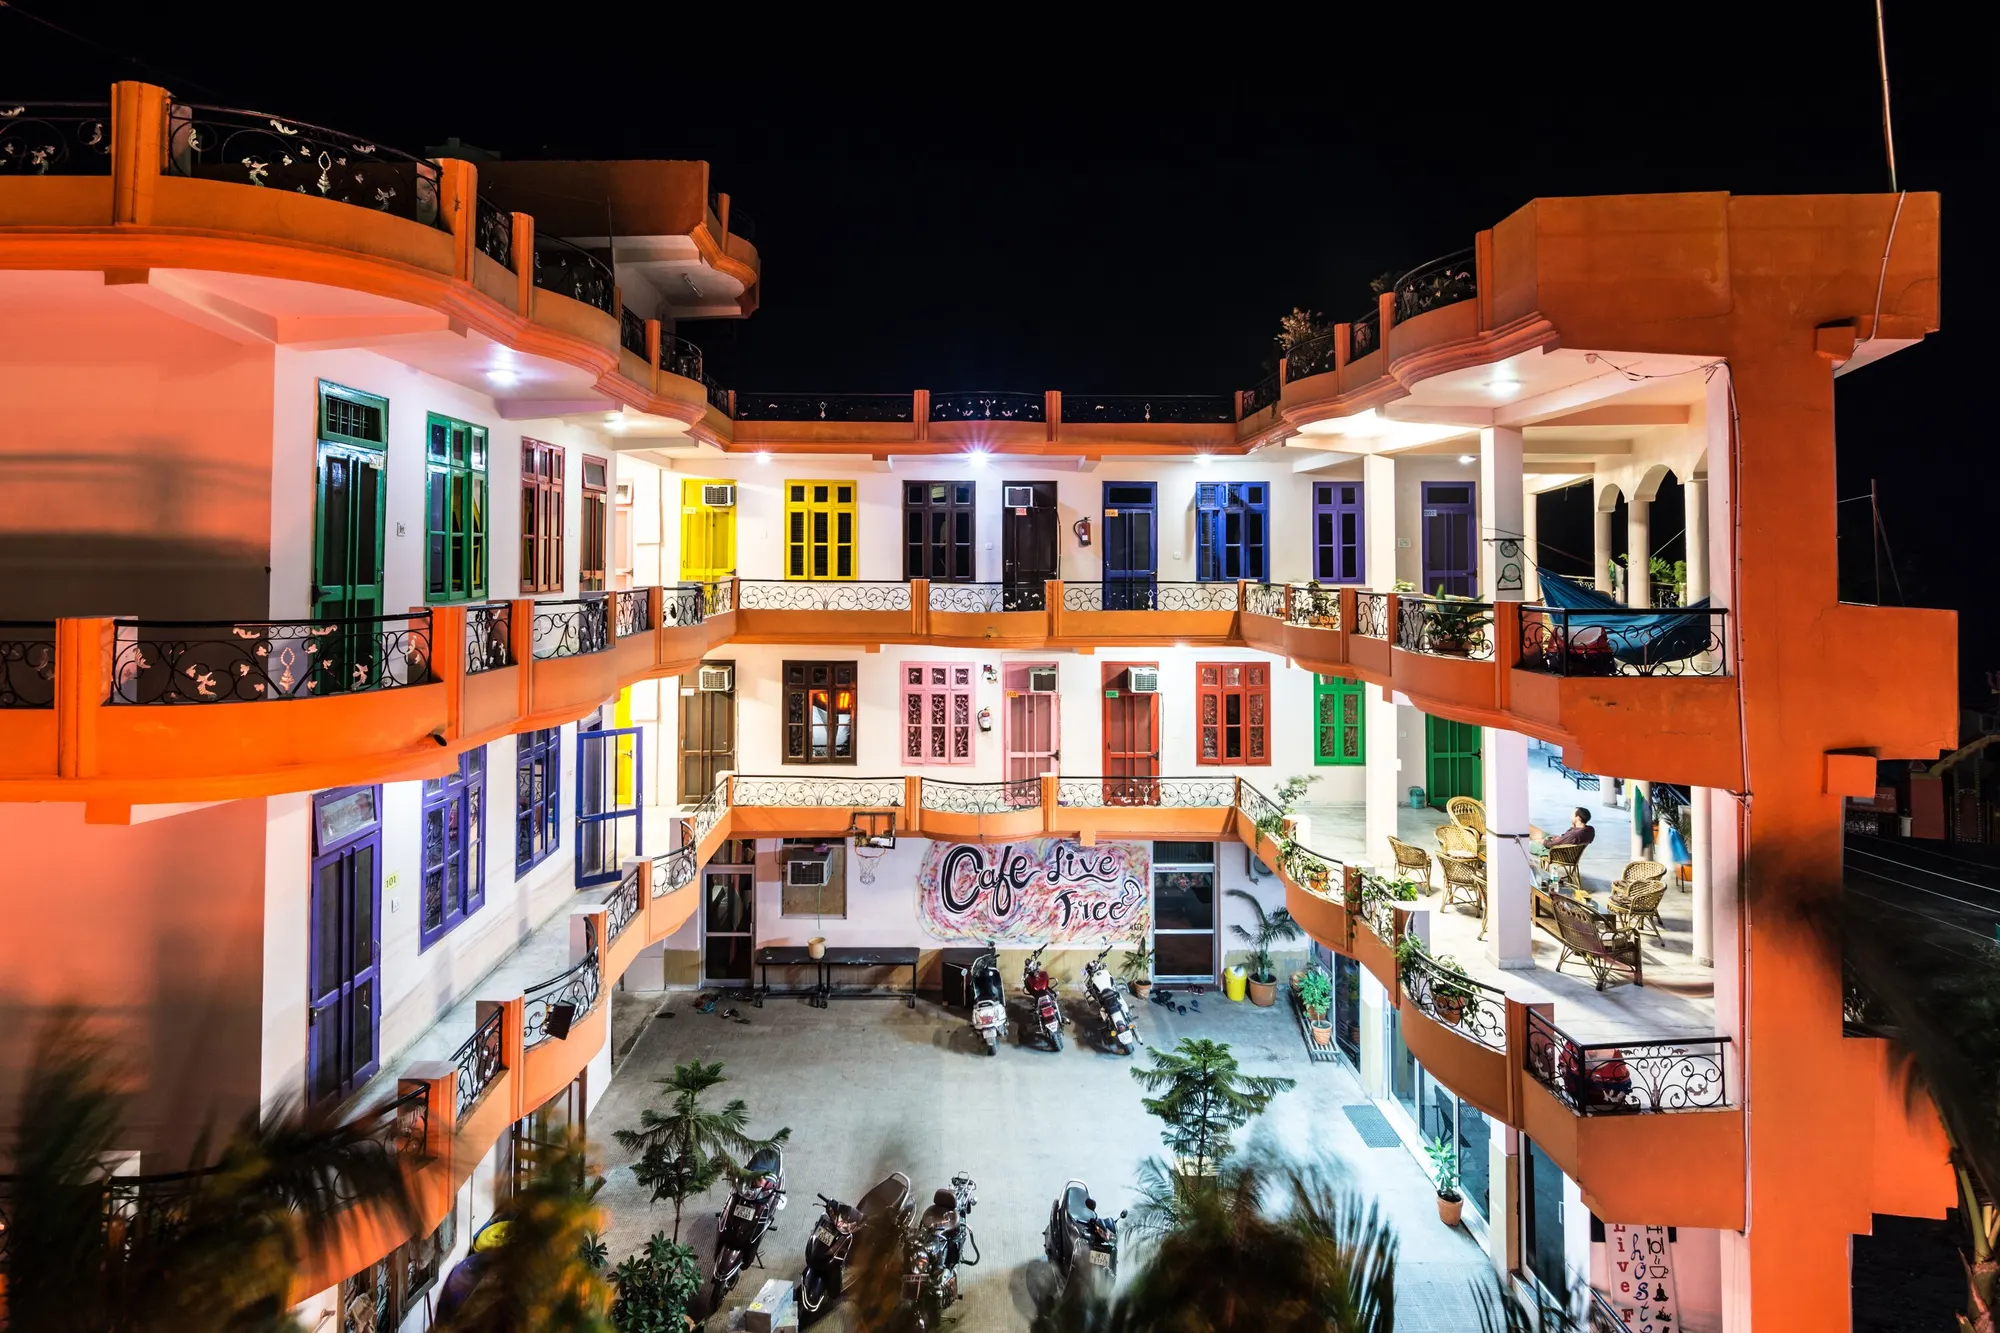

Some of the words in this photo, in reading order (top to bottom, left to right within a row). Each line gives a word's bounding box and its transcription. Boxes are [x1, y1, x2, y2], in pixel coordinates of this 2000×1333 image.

[386, 875, 397, 888] 101
[941, 846, 1042, 917] Cafe
[1046, 846, 1121, 884] Live
[1055, 889, 1127, 928] Free
